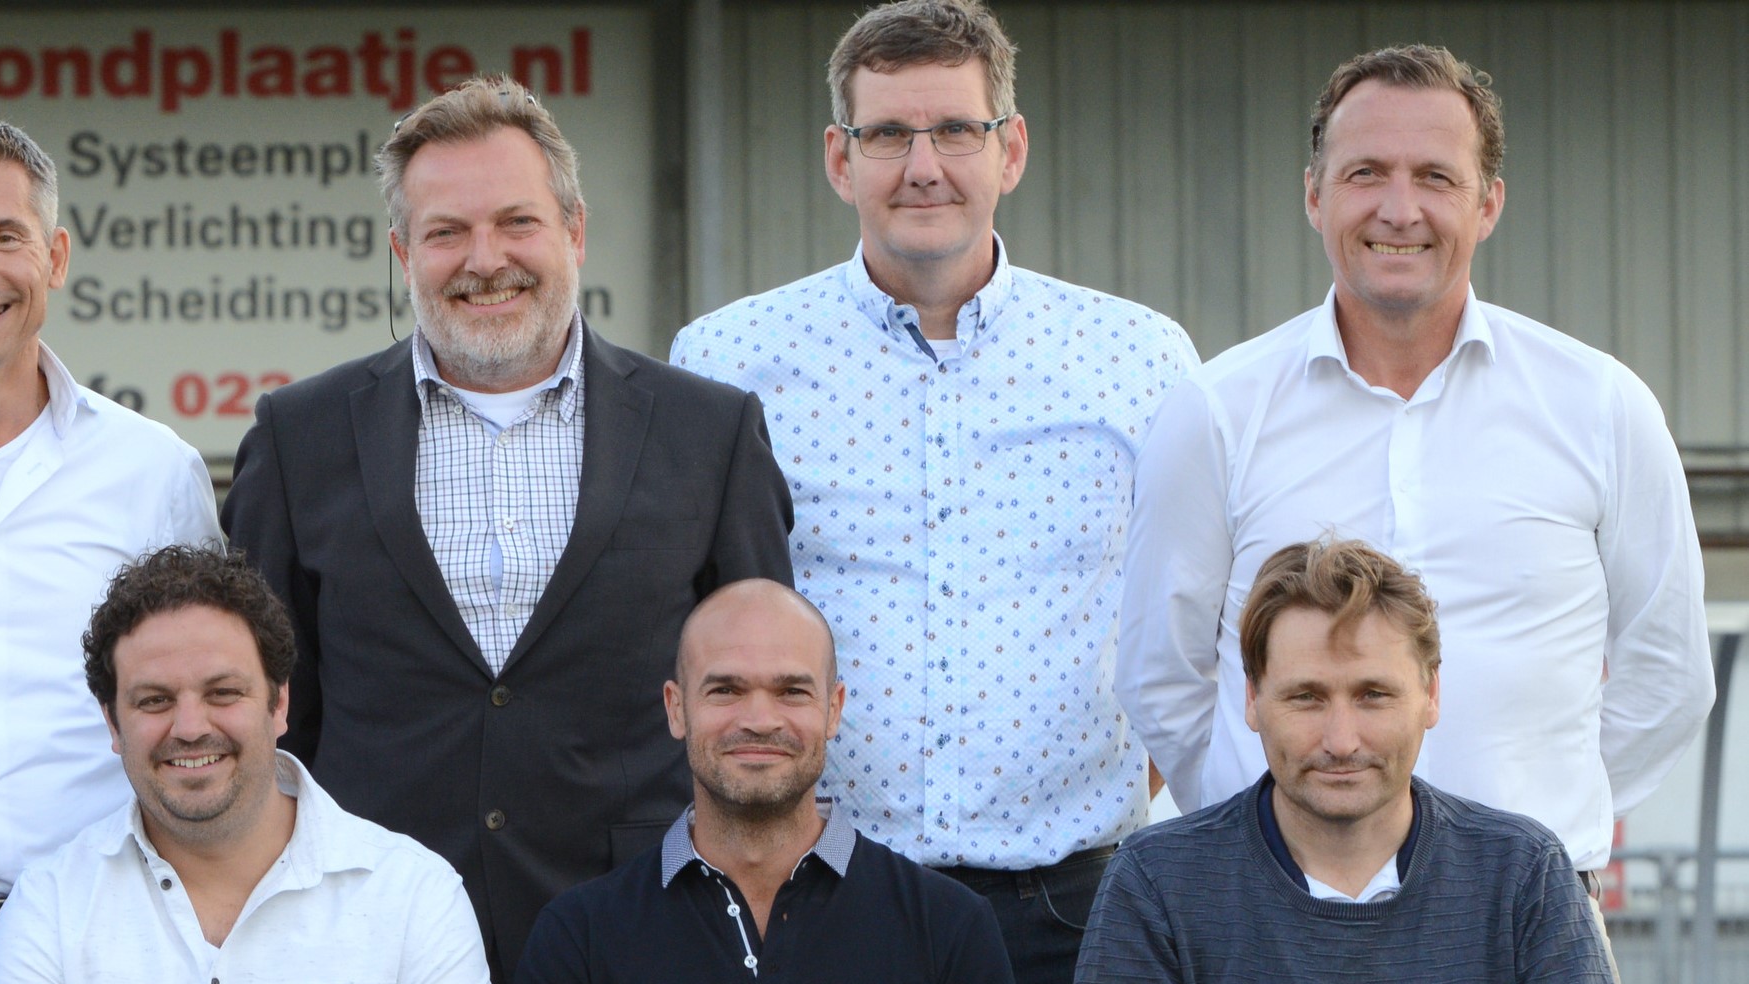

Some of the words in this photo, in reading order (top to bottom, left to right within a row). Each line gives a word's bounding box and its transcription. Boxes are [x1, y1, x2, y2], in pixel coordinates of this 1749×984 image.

[67, 129, 381, 187] Systeempl
[68, 203, 375, 259] Verlichting
[69, 275, 612, 331] Scheidingswn
